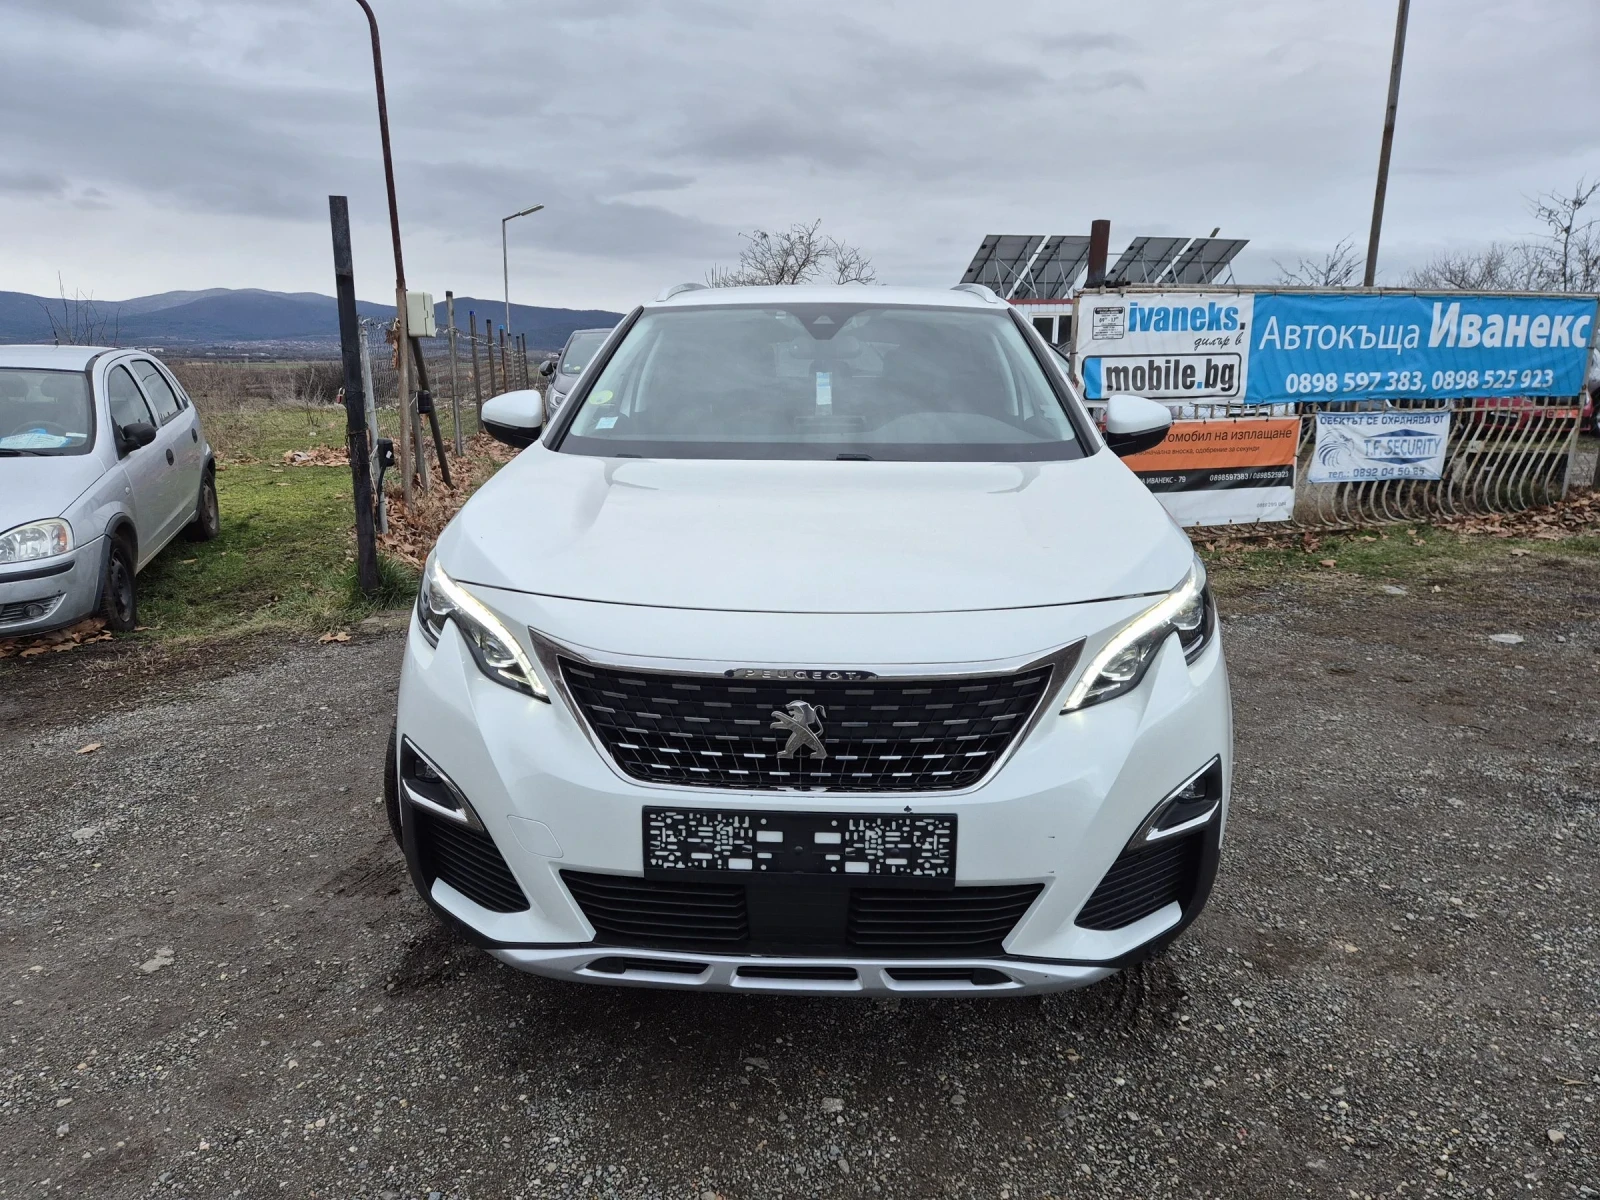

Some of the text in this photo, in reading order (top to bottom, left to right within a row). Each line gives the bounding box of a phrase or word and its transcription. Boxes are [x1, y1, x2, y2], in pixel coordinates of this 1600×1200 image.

[1259, 302, 1591, 355] Автокъща Иванекс
[1106, 359, 1235, 392] mobile.bg
[1285, 369, 1554, 394] 0898 597 383, 0898 525 923
[1320, 415, 1445, 426] ОБЕКТЪТ СЕ ОХРАНЯВА ОТ
[1214, 431, 1228, 441] на
[1231, 429, 1292, 442] изплащане
[1384, 438, 1442, 456] SECURITY
[1353, 468, 1378, 478] 0892
[1381, 468, 1394, 477] 04
[1397, 467, 1410, 476] 50
[1146, 476, 1174, 484] ИВАНЕКС
[1178, 475, 1187, 483] 79
[744, 669, 858, 681] PEUGEOT
